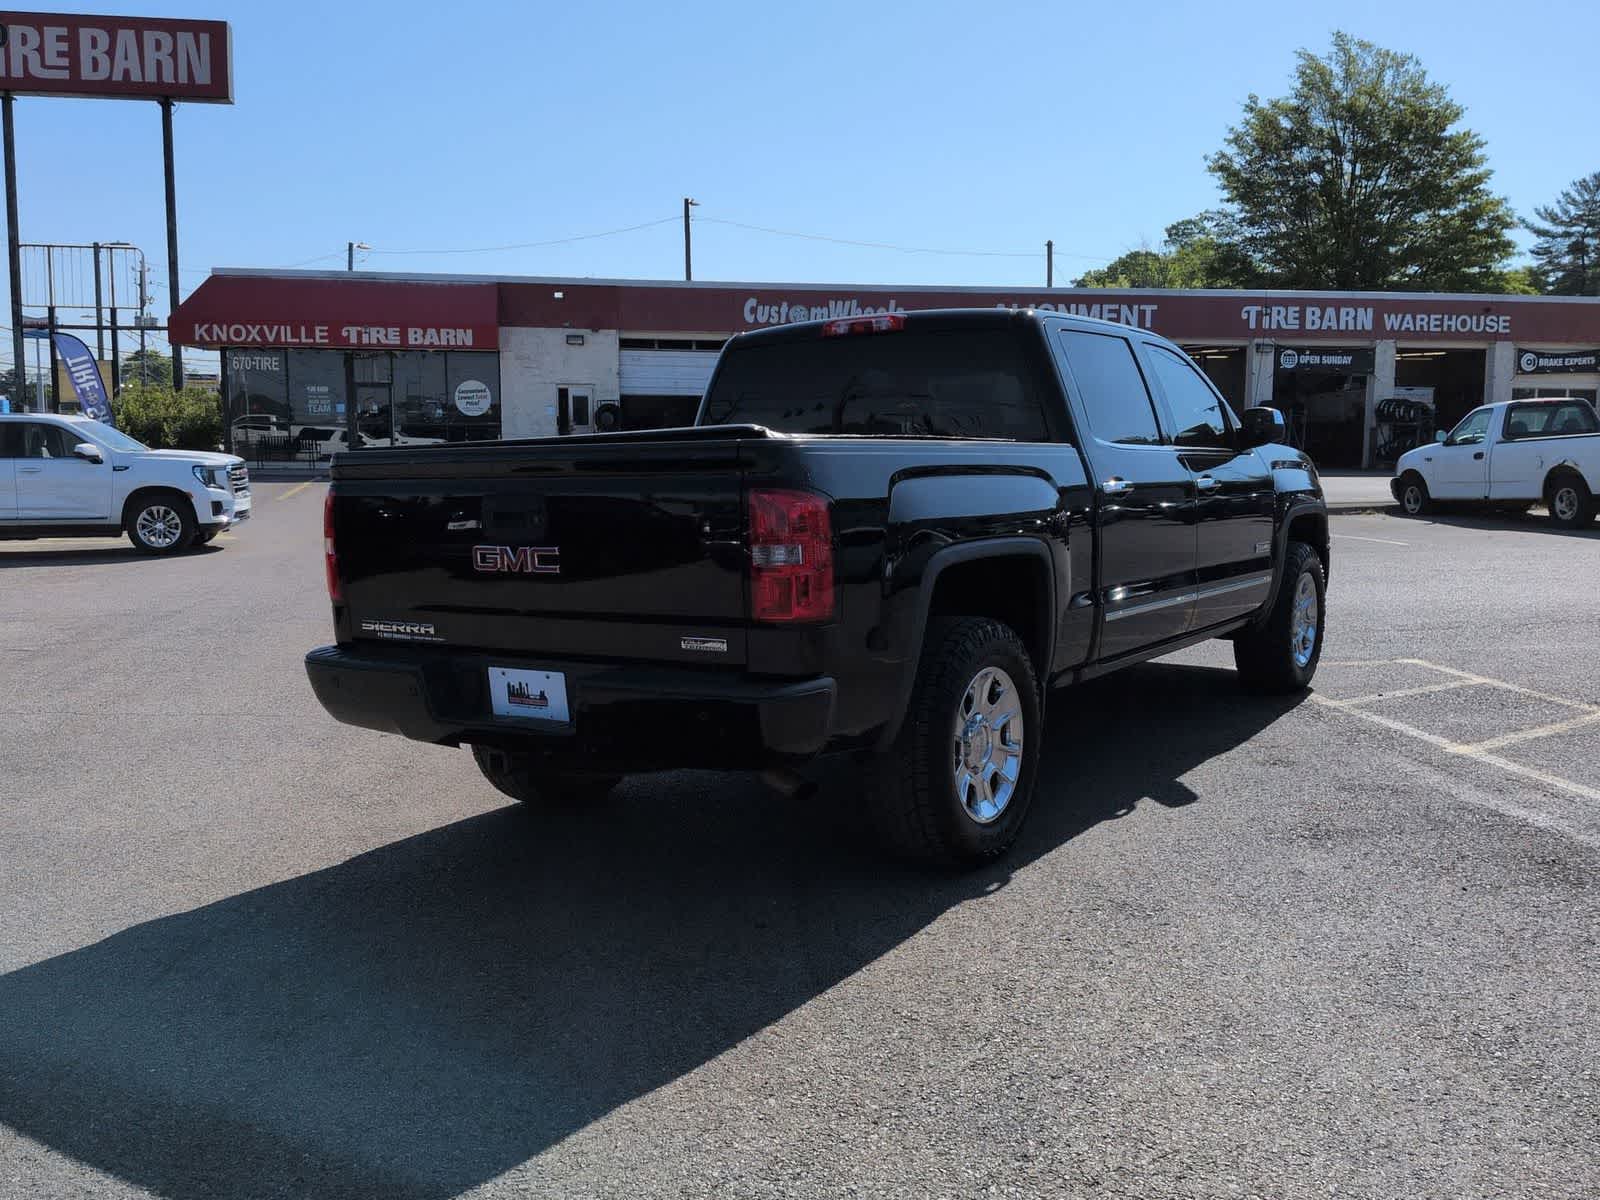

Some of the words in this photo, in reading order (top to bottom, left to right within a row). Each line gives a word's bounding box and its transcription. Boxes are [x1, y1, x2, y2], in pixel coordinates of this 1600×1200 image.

[78, 27, 211, 85] BARN
[1305, 306, 1373, 331] BARN
[1383, 312, 1511, 333] WAREHOUSE
[194, 323, 329, 343] KNOXVILLE
[407, 327, 473, 346] BARN
[1299, 354, 1320, 364] OPEN
[1321, 354, 1353, 365] SUNDAY
[472, 545, 561, 573] GMC
[361, 619, 435, 635] SIERRA
